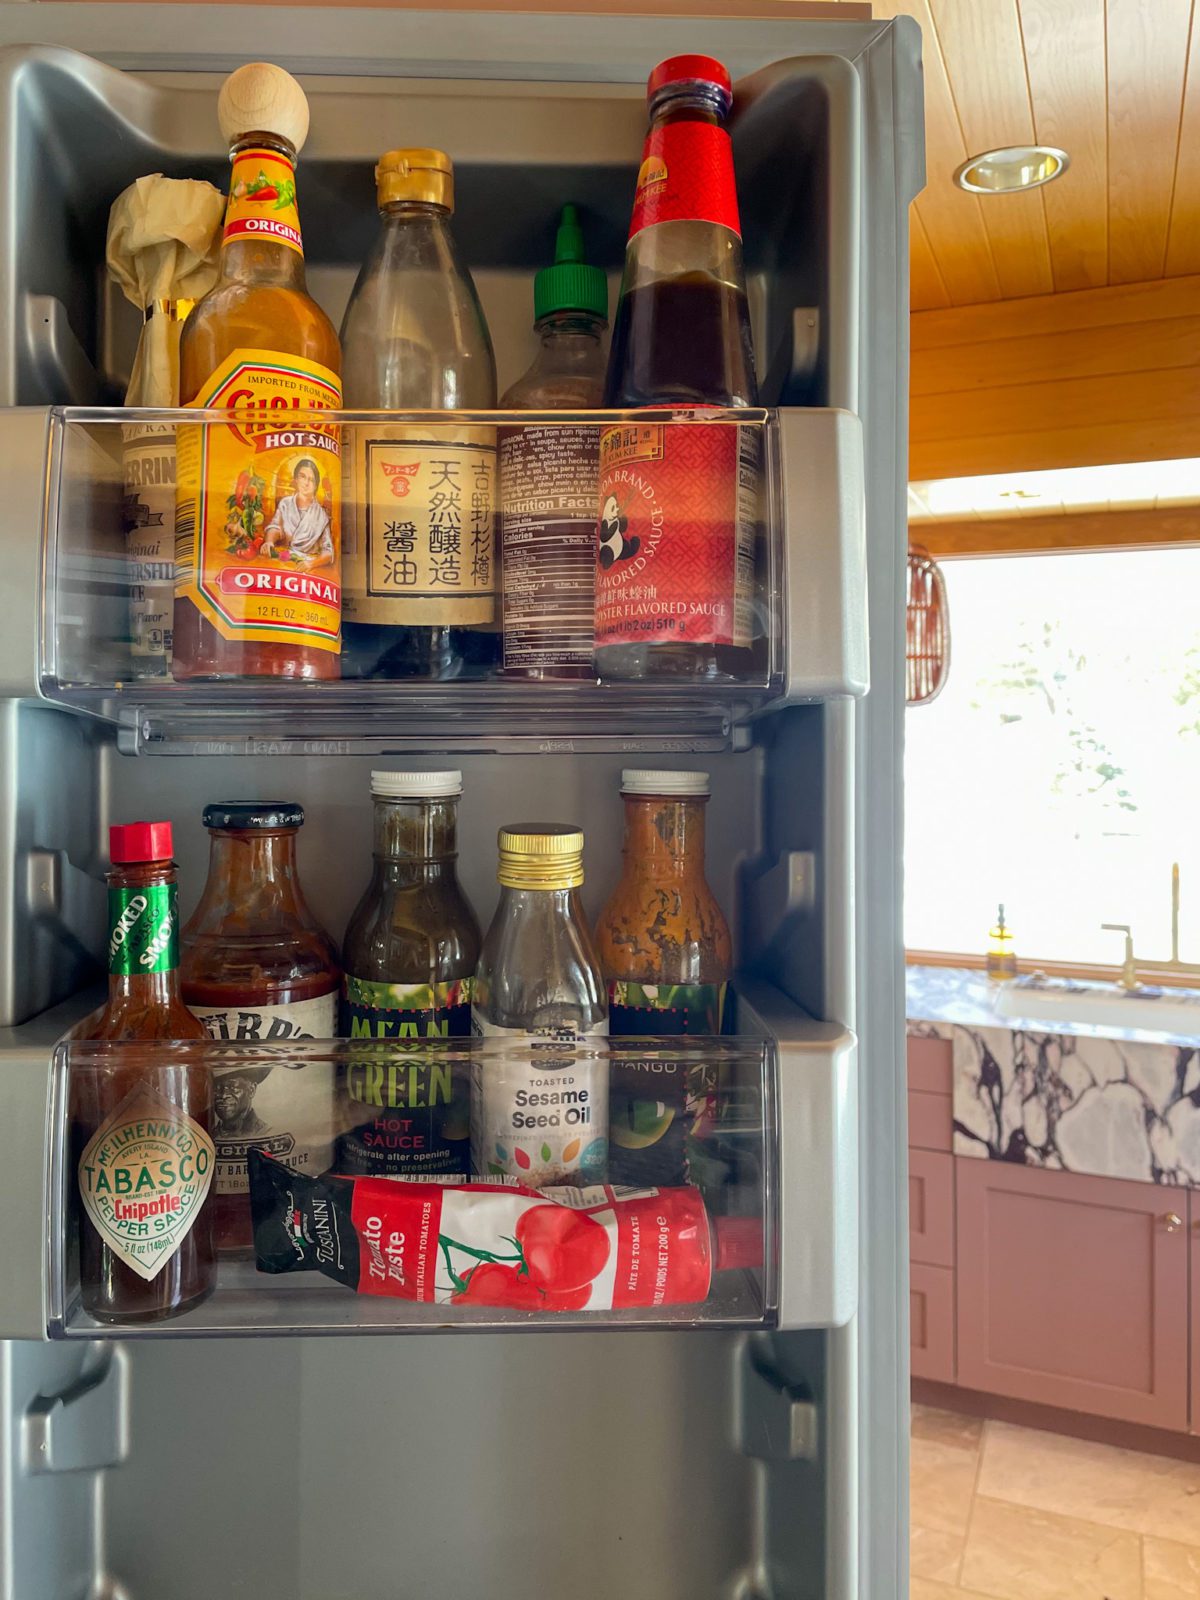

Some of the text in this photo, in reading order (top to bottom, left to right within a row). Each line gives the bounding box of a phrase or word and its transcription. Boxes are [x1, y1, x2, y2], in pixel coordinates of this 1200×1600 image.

[248, 375, 297, 390] IMPORTED
[299, 383, 321, 398] FROM
[265, 432, 304, 448] HOT
[544, 429, 560, 438] from
[544, 459, 567, 468] picante
[614, 470, 655, 499] BRAND
[503, 496, 599, 515] Nutrition Facts
[503, 531, 533, 542] Calories
[643, 506, 664, 557] SAUCE
[599, 556, 647, 589] LAVORED
[233, 571, 338, 604] ORIGINAL
[257, 606, 268, 616] 12
[271, 607, 281, 617] FL
[284, 608, 296, 619] OZ
[305, 611, 319, 623] 360
[624, 602, 687, 616] FLAVORED
[689, 603, 726, 617] SAUCE
[679, 622, 685, 632] g
[346, 1064, 454, 1108] GREEN
[529, 1077, 575, 1087] TOASTED
[515, 1089, 589, 1107] Sesame
[374, 1118, 414, 1133] HOT
[512, 1106, 591, 1129] Seed Oil
[363, 1132, 425, 1149] SAUCE
[121, 1143, 168, 1160] AVERY ISLAND
[387, 1150, 411, 1162] after
[413, 1148, 450, 1162] opening
[84, 1148, 209, 1194] TABASCO
[386, 1163, 398, 1172] no
[97, 1183, 196, 1236] PEPPER SAUCE
[311, 1197, 334, 1263] TUSCANINI
[419, 1201, 432, 1251] TOMATOES
[124, 1244, 130, 1253] 5
[136, 1245, 145, 1254] oz
[147, 1233, 175, 1253] (148mL)
[630, 1216, 640, 1257] TOMATE
[658, 1233, 669, 1251] 200
[363, 1216, 386, 1281] Tomato
[385, 1231, 406, 1286] Paste
[631, 1260, 640, 1272] DE
[658, 1251, 669, 1266] NET
[416, 1252, 426, 1290] ITALIAN
